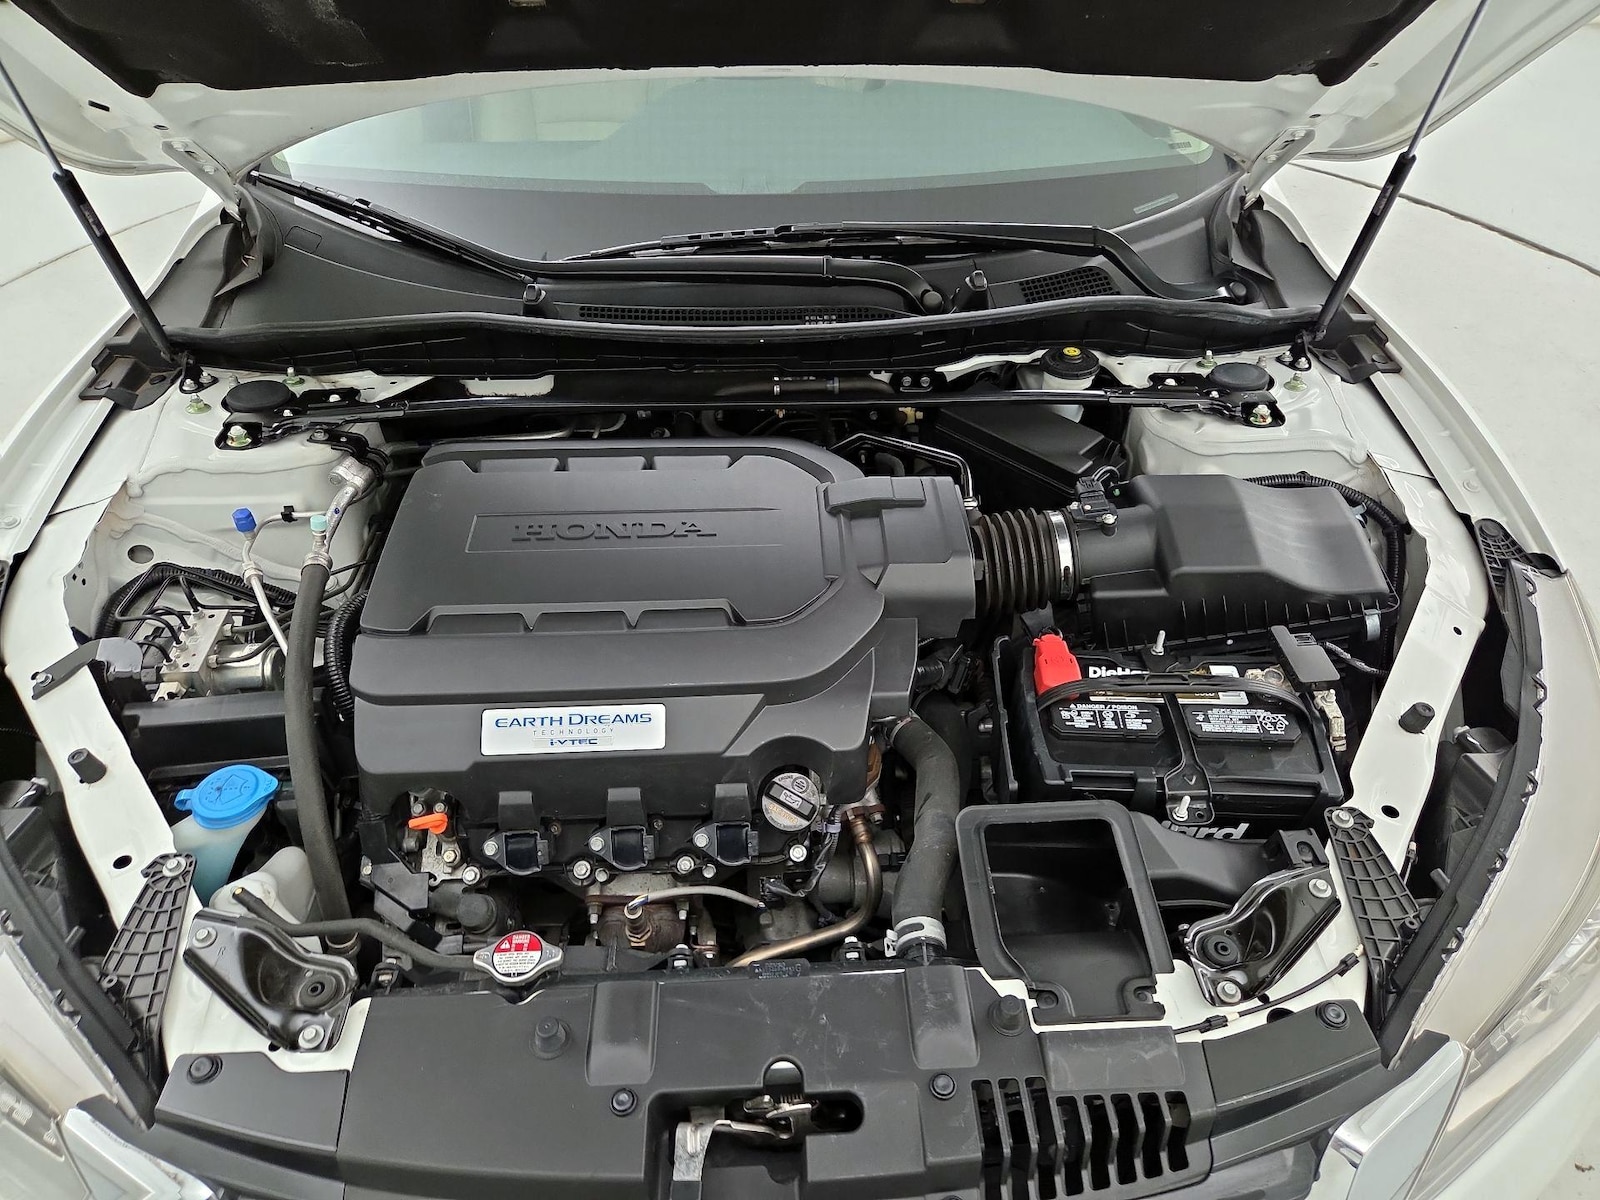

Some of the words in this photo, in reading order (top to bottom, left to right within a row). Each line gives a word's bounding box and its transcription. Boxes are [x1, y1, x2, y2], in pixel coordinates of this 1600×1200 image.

[511, 521, 717, 541] HONDA
[495, 716, 563, 728] EARTH
[568, 713, 652, 726] DREAMS
[532, 727, 614, 736] TECHNOLOGY
[550, 738, 598, 746] i-VTEC
